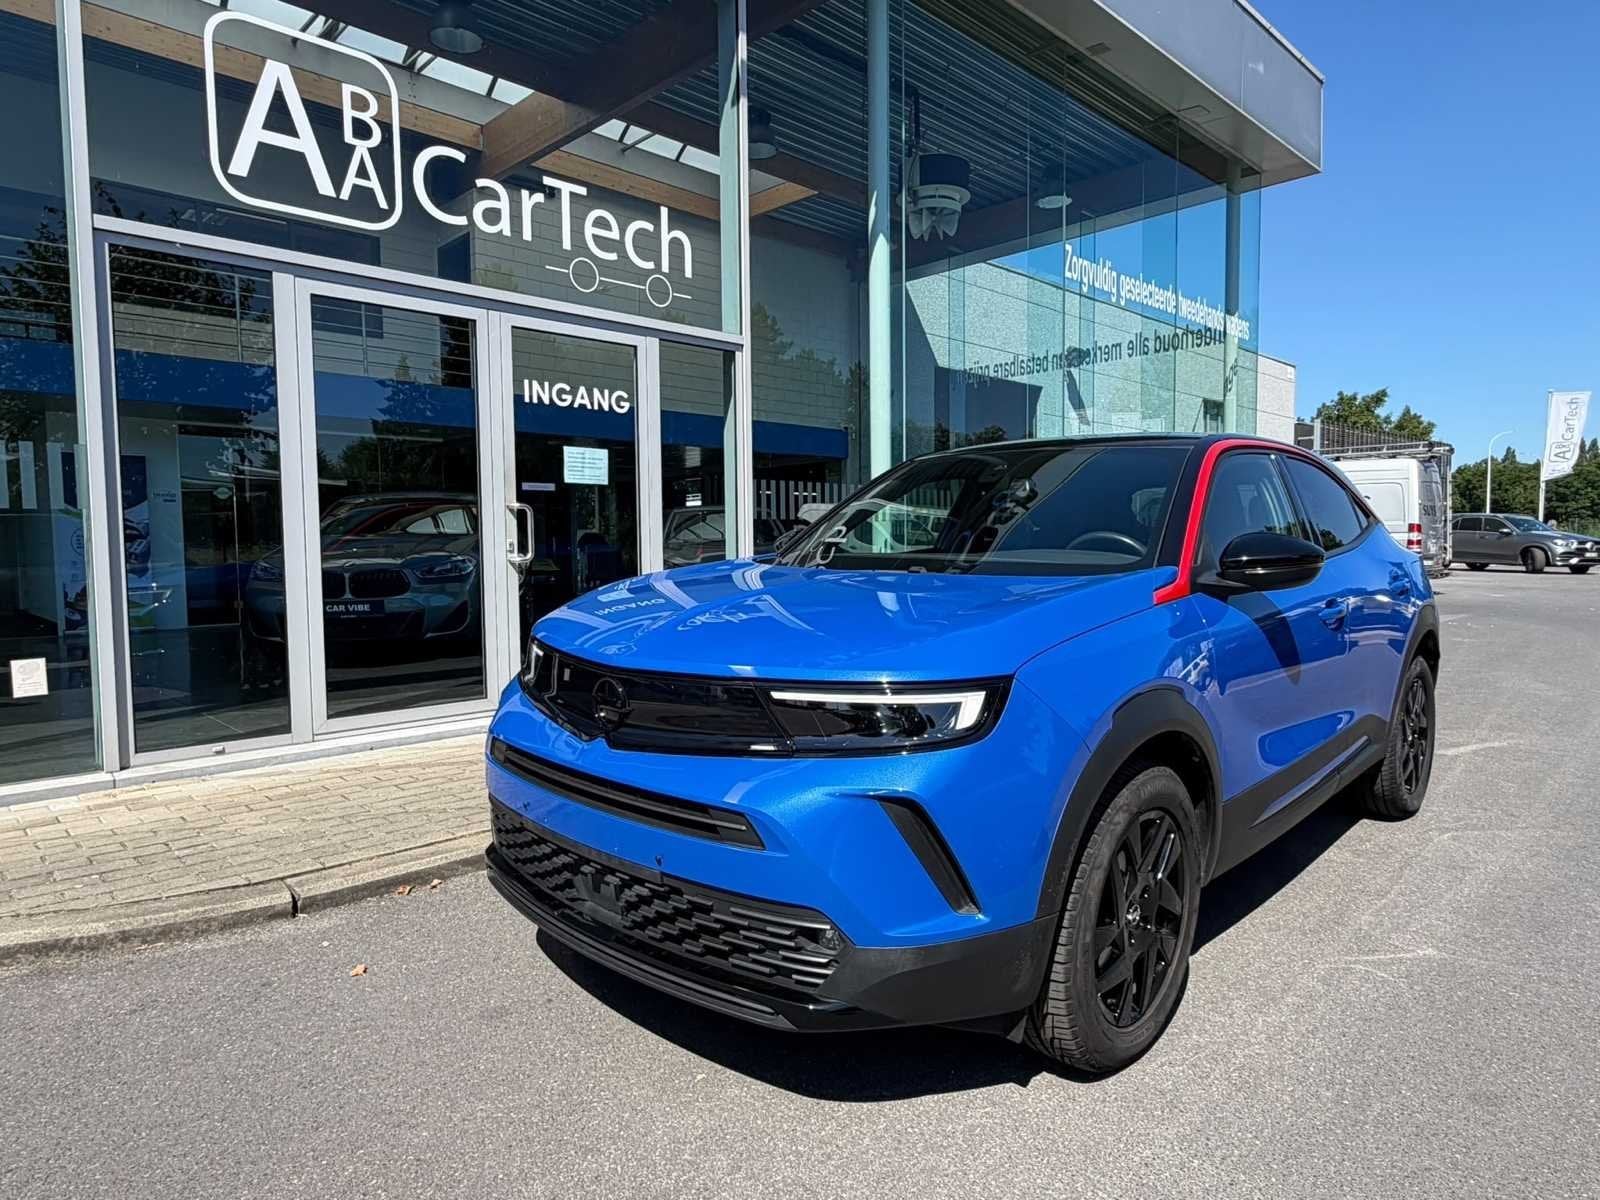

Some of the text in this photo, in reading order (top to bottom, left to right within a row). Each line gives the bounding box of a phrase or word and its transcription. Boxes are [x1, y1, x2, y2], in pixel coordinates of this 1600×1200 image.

[413, 145, 693, 280] CarTech
[1064, 243, 1117, 303] Zorgvuldig
[1119, 272, 1177, 316] geselecteerde
[523, 379, 631, 415] INGANG
[1561, 397, 1581, 442] CarTech
[326, 603, 371, 613] CAR VIBE
